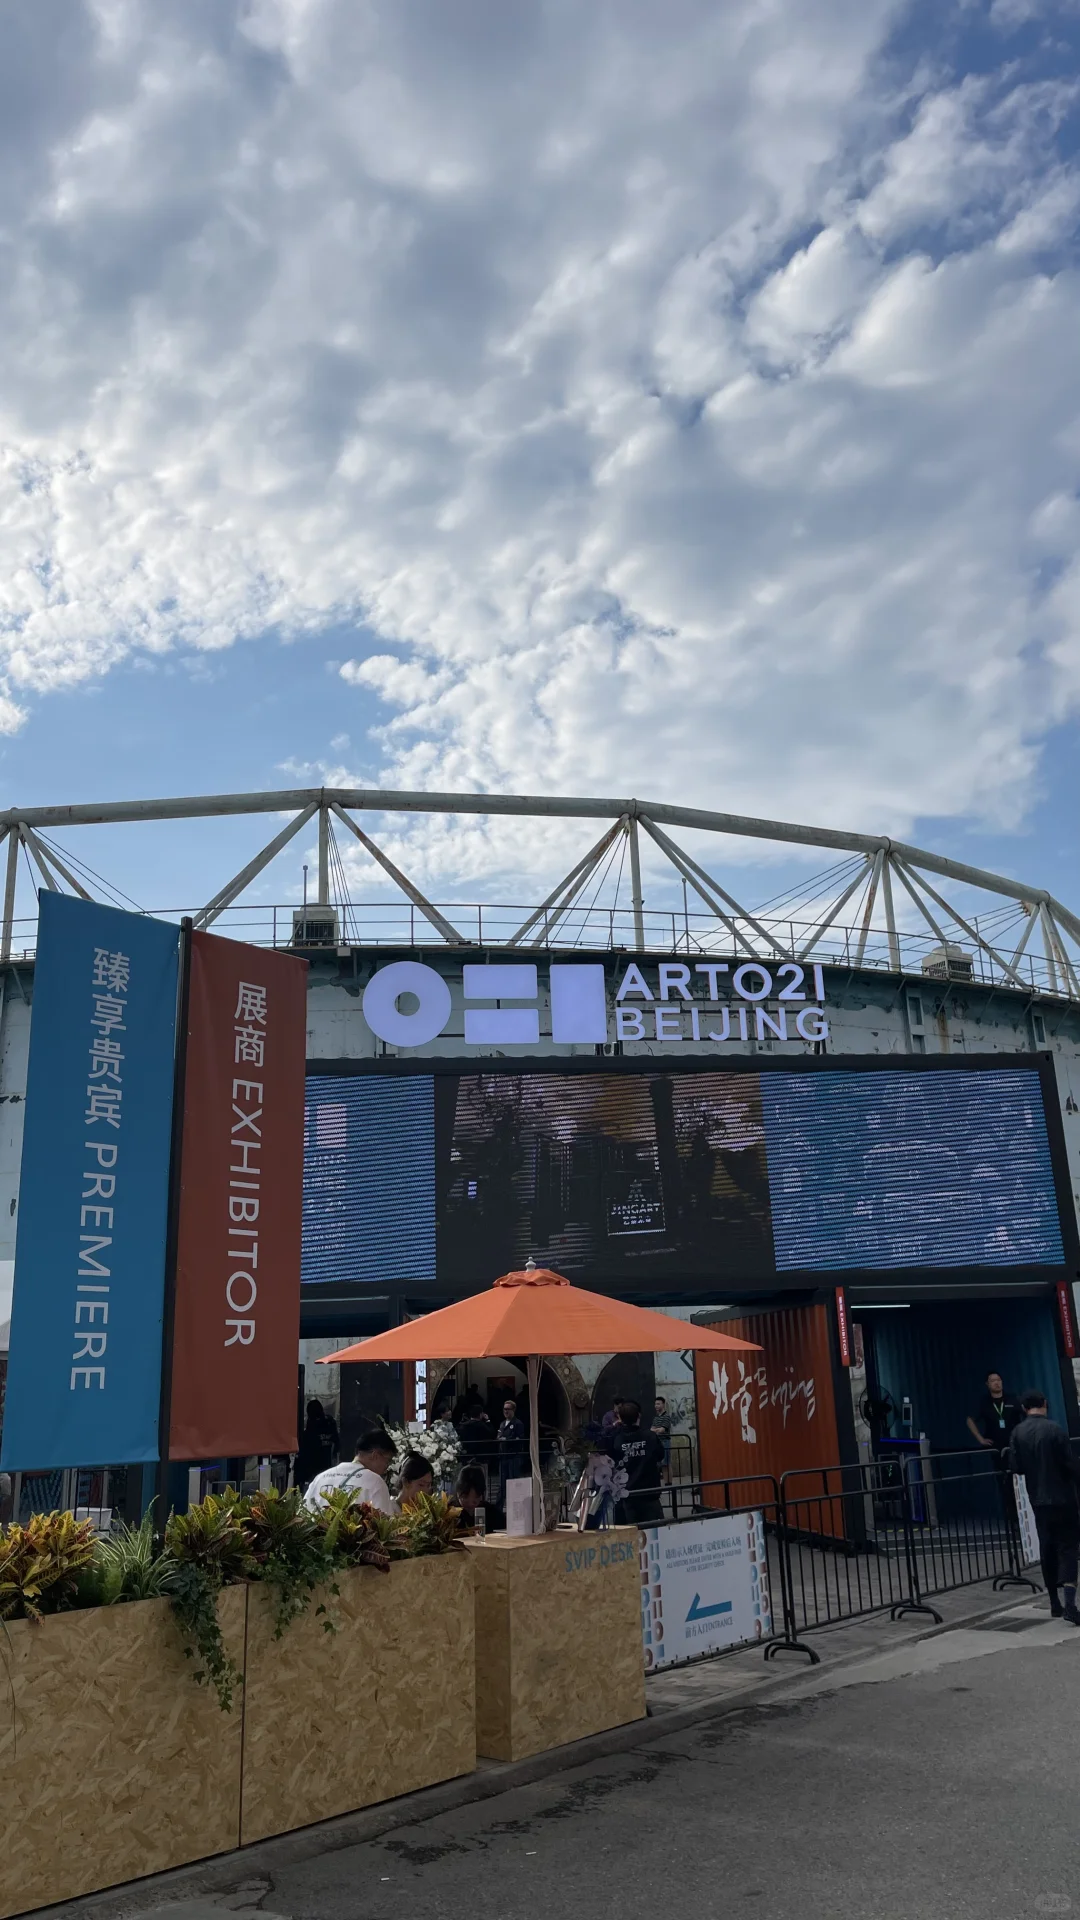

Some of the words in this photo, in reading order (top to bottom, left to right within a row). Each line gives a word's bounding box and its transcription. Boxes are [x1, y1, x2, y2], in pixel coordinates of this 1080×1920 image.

[84, 946, 131, 1129] 臻享贵宾
[233, 981, 268, 1068] 展商
[616, 1006, 829, 1041] BEIJING
[223, 1078, 264, 1347] EXHIBITOR
[69, 1141, 118, 1391] PREMIERE
[839, 1312, 848, 1356] EXHIBITOR
[1062, 1306, 1072, 1348] EXHIBITOR
[565, 1547, 596, 1572] SVIP
[600, 1541, 634, 1566] DESK
